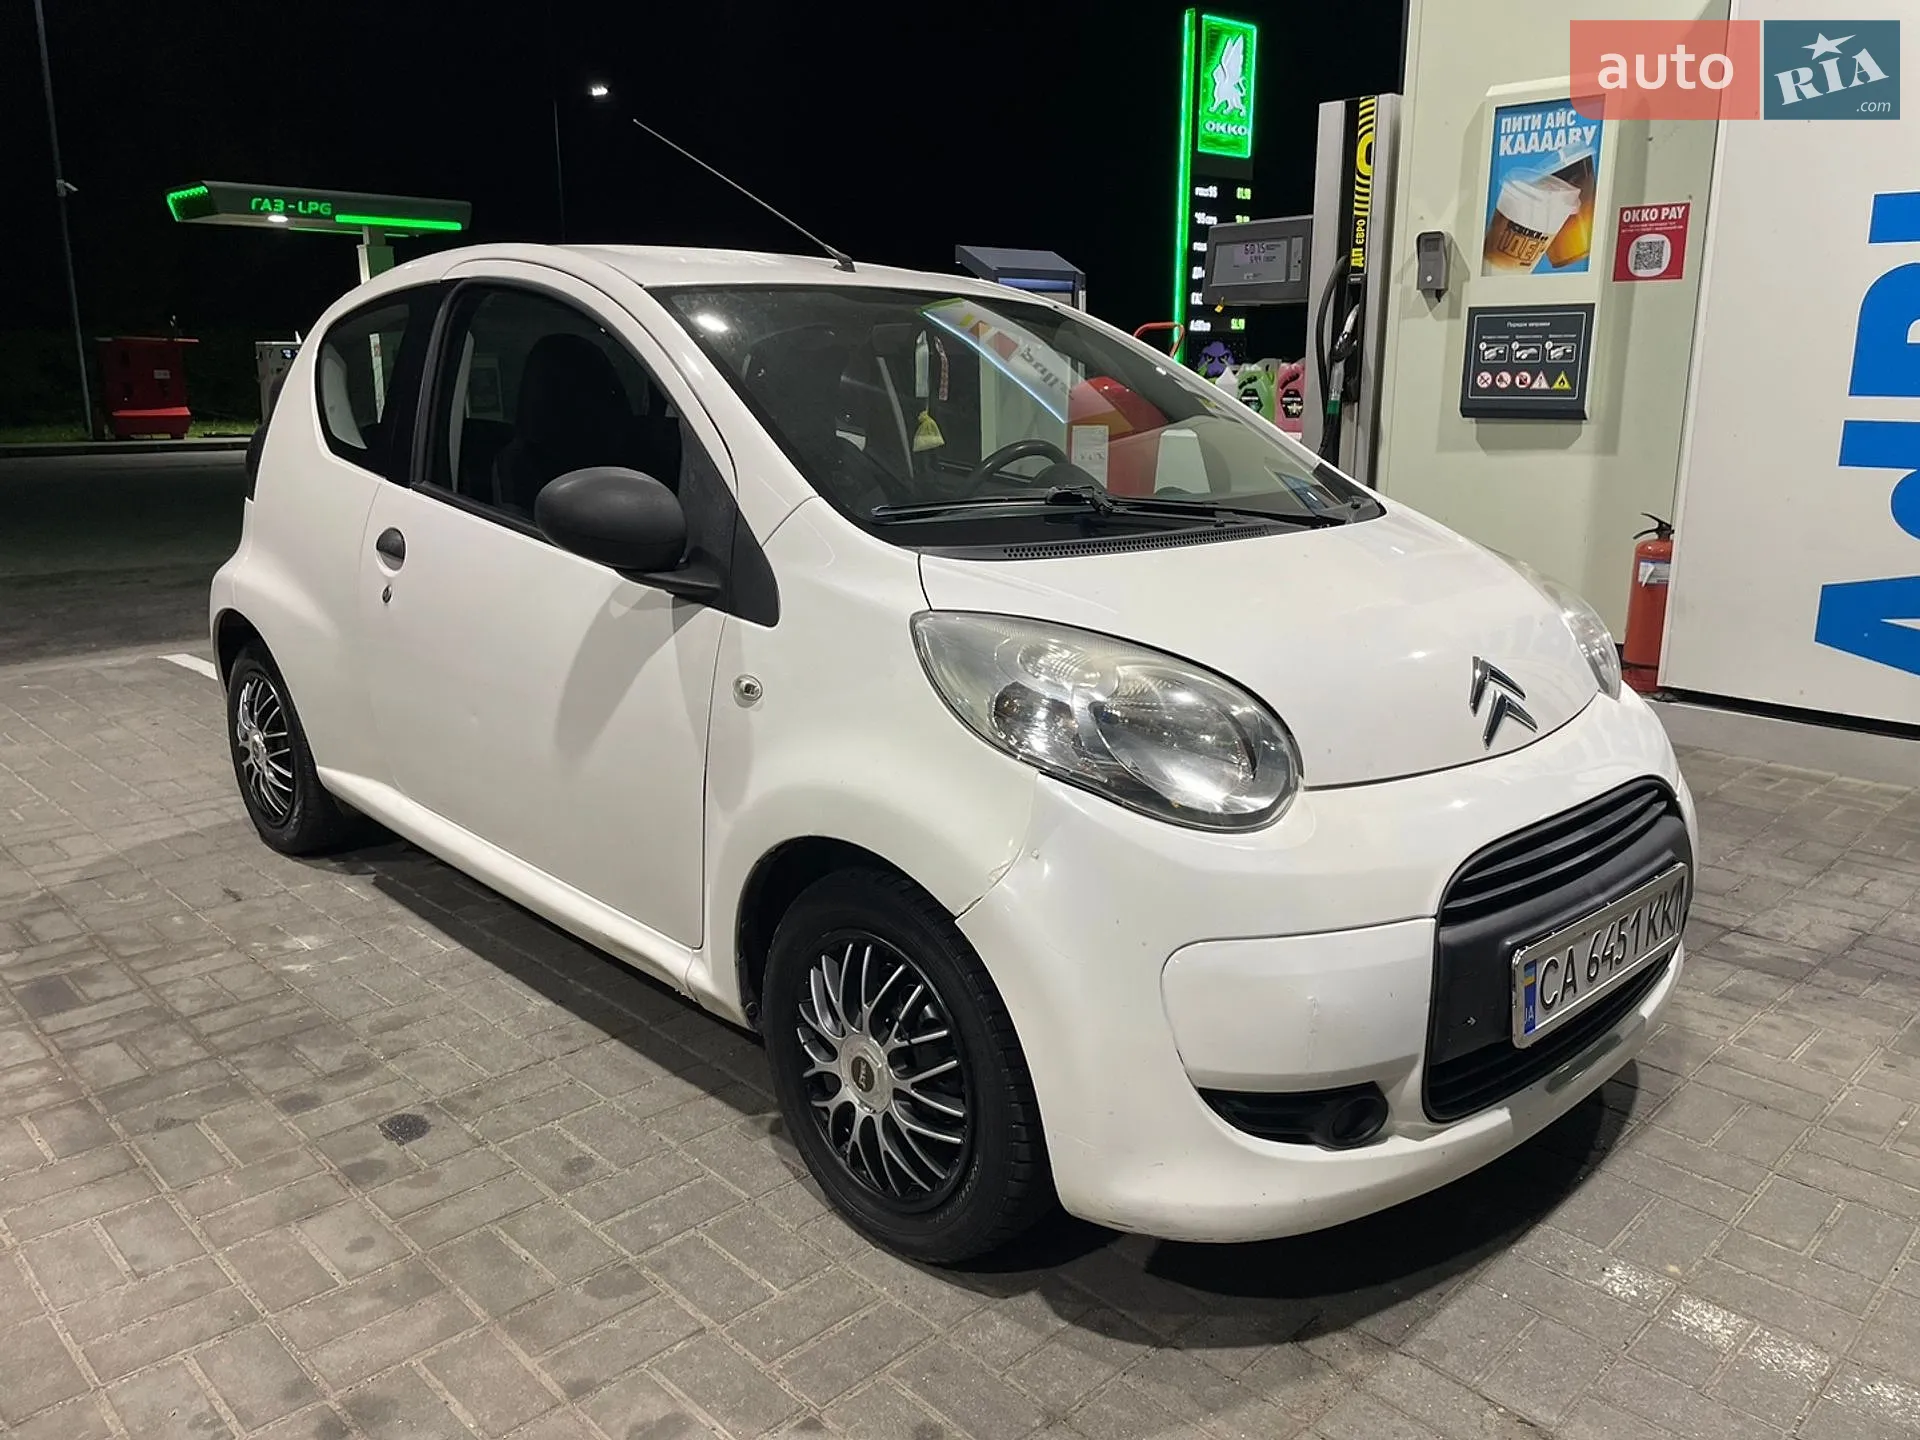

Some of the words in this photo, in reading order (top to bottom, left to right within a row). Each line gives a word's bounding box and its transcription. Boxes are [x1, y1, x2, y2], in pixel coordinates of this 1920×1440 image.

[1205, 120, 1247, 136] OKKO
[1501, 113, 1542, 134] ПИТИ
[1544, 108, 1577, 129] АЙС
[1623, 208, 1659, 223] OKKO
[1661, 206, 1686, 220] PAY
[1540, 945, 1578, 1011] CA
[1587, 906, 1643, 983] 6451
[1646, 884, 1678, 948] KK
